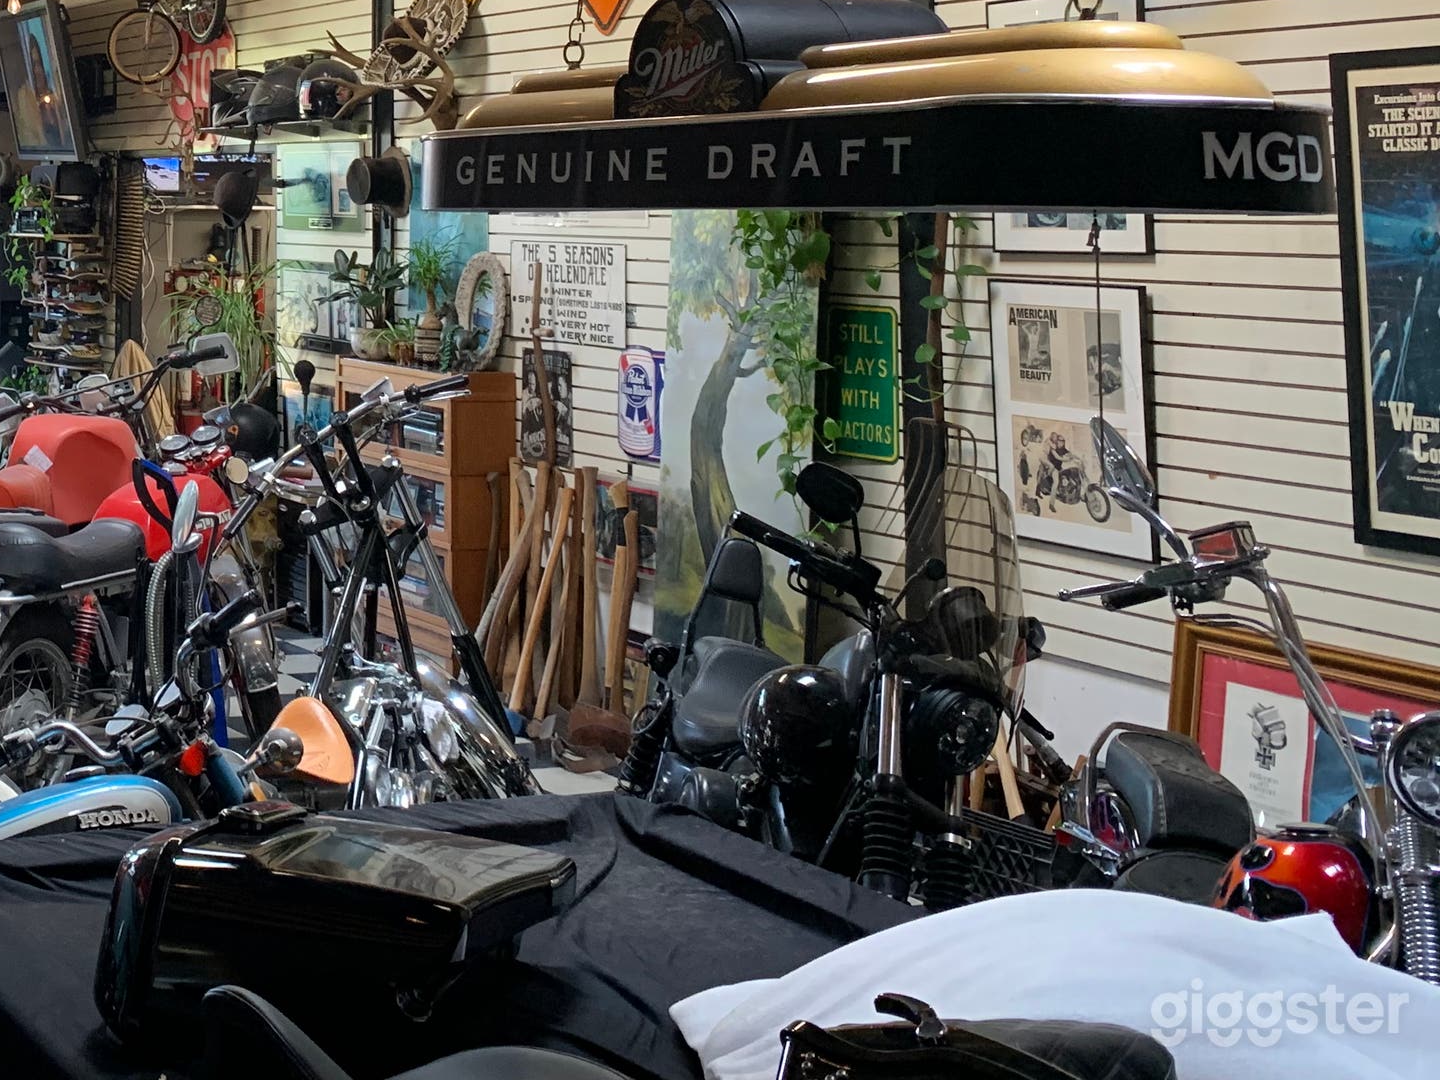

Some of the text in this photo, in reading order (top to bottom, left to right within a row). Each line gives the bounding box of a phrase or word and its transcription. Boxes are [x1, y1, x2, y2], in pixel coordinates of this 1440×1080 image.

[634, 40, 724, 96] Miller
[1382, 108, 1406, 122] THE
[1368, 123, 1418, 137] STARTED
[1421, 122, 1433, 135] IT
[1383, 138, 1428, 152] CLASSIC
[456, 137, 912, 185] GENUINE DRAFT
[1201, 131, 1324, 182] MGD
[522, 244, 540, 262] THE
[565, 245, 613, 266] SEASONS
[546, 264, 607, 286] HELENDALE
[518, 295, 554, 306] SPNG
[552, 287, 593, 298] WINTER
[557, 309, 587, 319] WIND
[1009, 307, 1058, 328] AMERICAN
[590, 324, 610, 333] HOT
[590, 334, 614, 344] NICE
[839, 323, 883, 345] STILL
[832, 354, 888, 378] PLAYS
[1020, 370, 1051, 381] BEAUTY
[841, 387, 880, 410] WITH
[840, 422, 892, 445] ACTORS
[78, 808, 160, 829] HONDA
